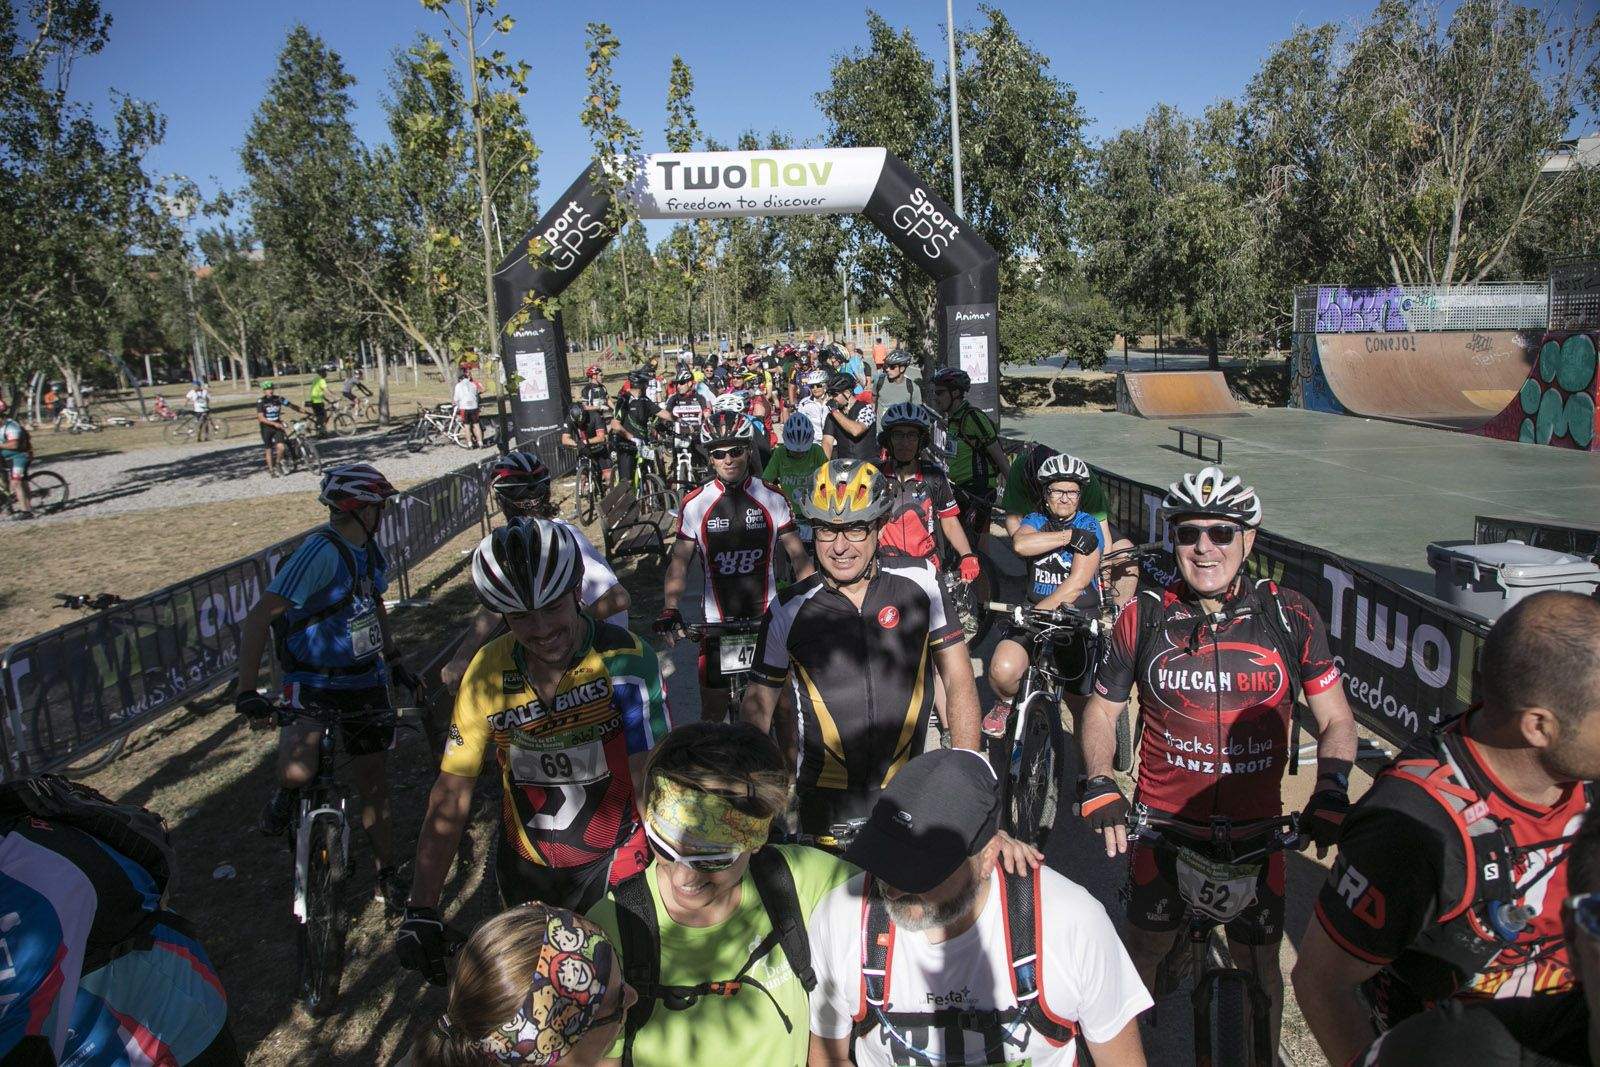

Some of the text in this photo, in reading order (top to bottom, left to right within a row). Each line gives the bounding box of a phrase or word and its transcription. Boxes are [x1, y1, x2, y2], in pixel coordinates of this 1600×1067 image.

[656, 158, 834, 191] TwoNav
[666, 194, 826, 212] freedom to discover
[539, 201, 584, 248] port
[892, 204, 949, 259] GPS
[549, 213, 606, 271] GPS
[513, 327, 546, 338] nima+
[715, 548, 764, 562] AUTO
[1158, 668, 1277, 693] VULCAN BIKE
[554, 677, 610, 713] BIKES
[1163, 728, 1273, 756] tracks de lava
[540, 752, 574, 779] 69
[1165, 751, 1273, 775] LANZAROTE
[1198, 880, 1231, 913] 52
